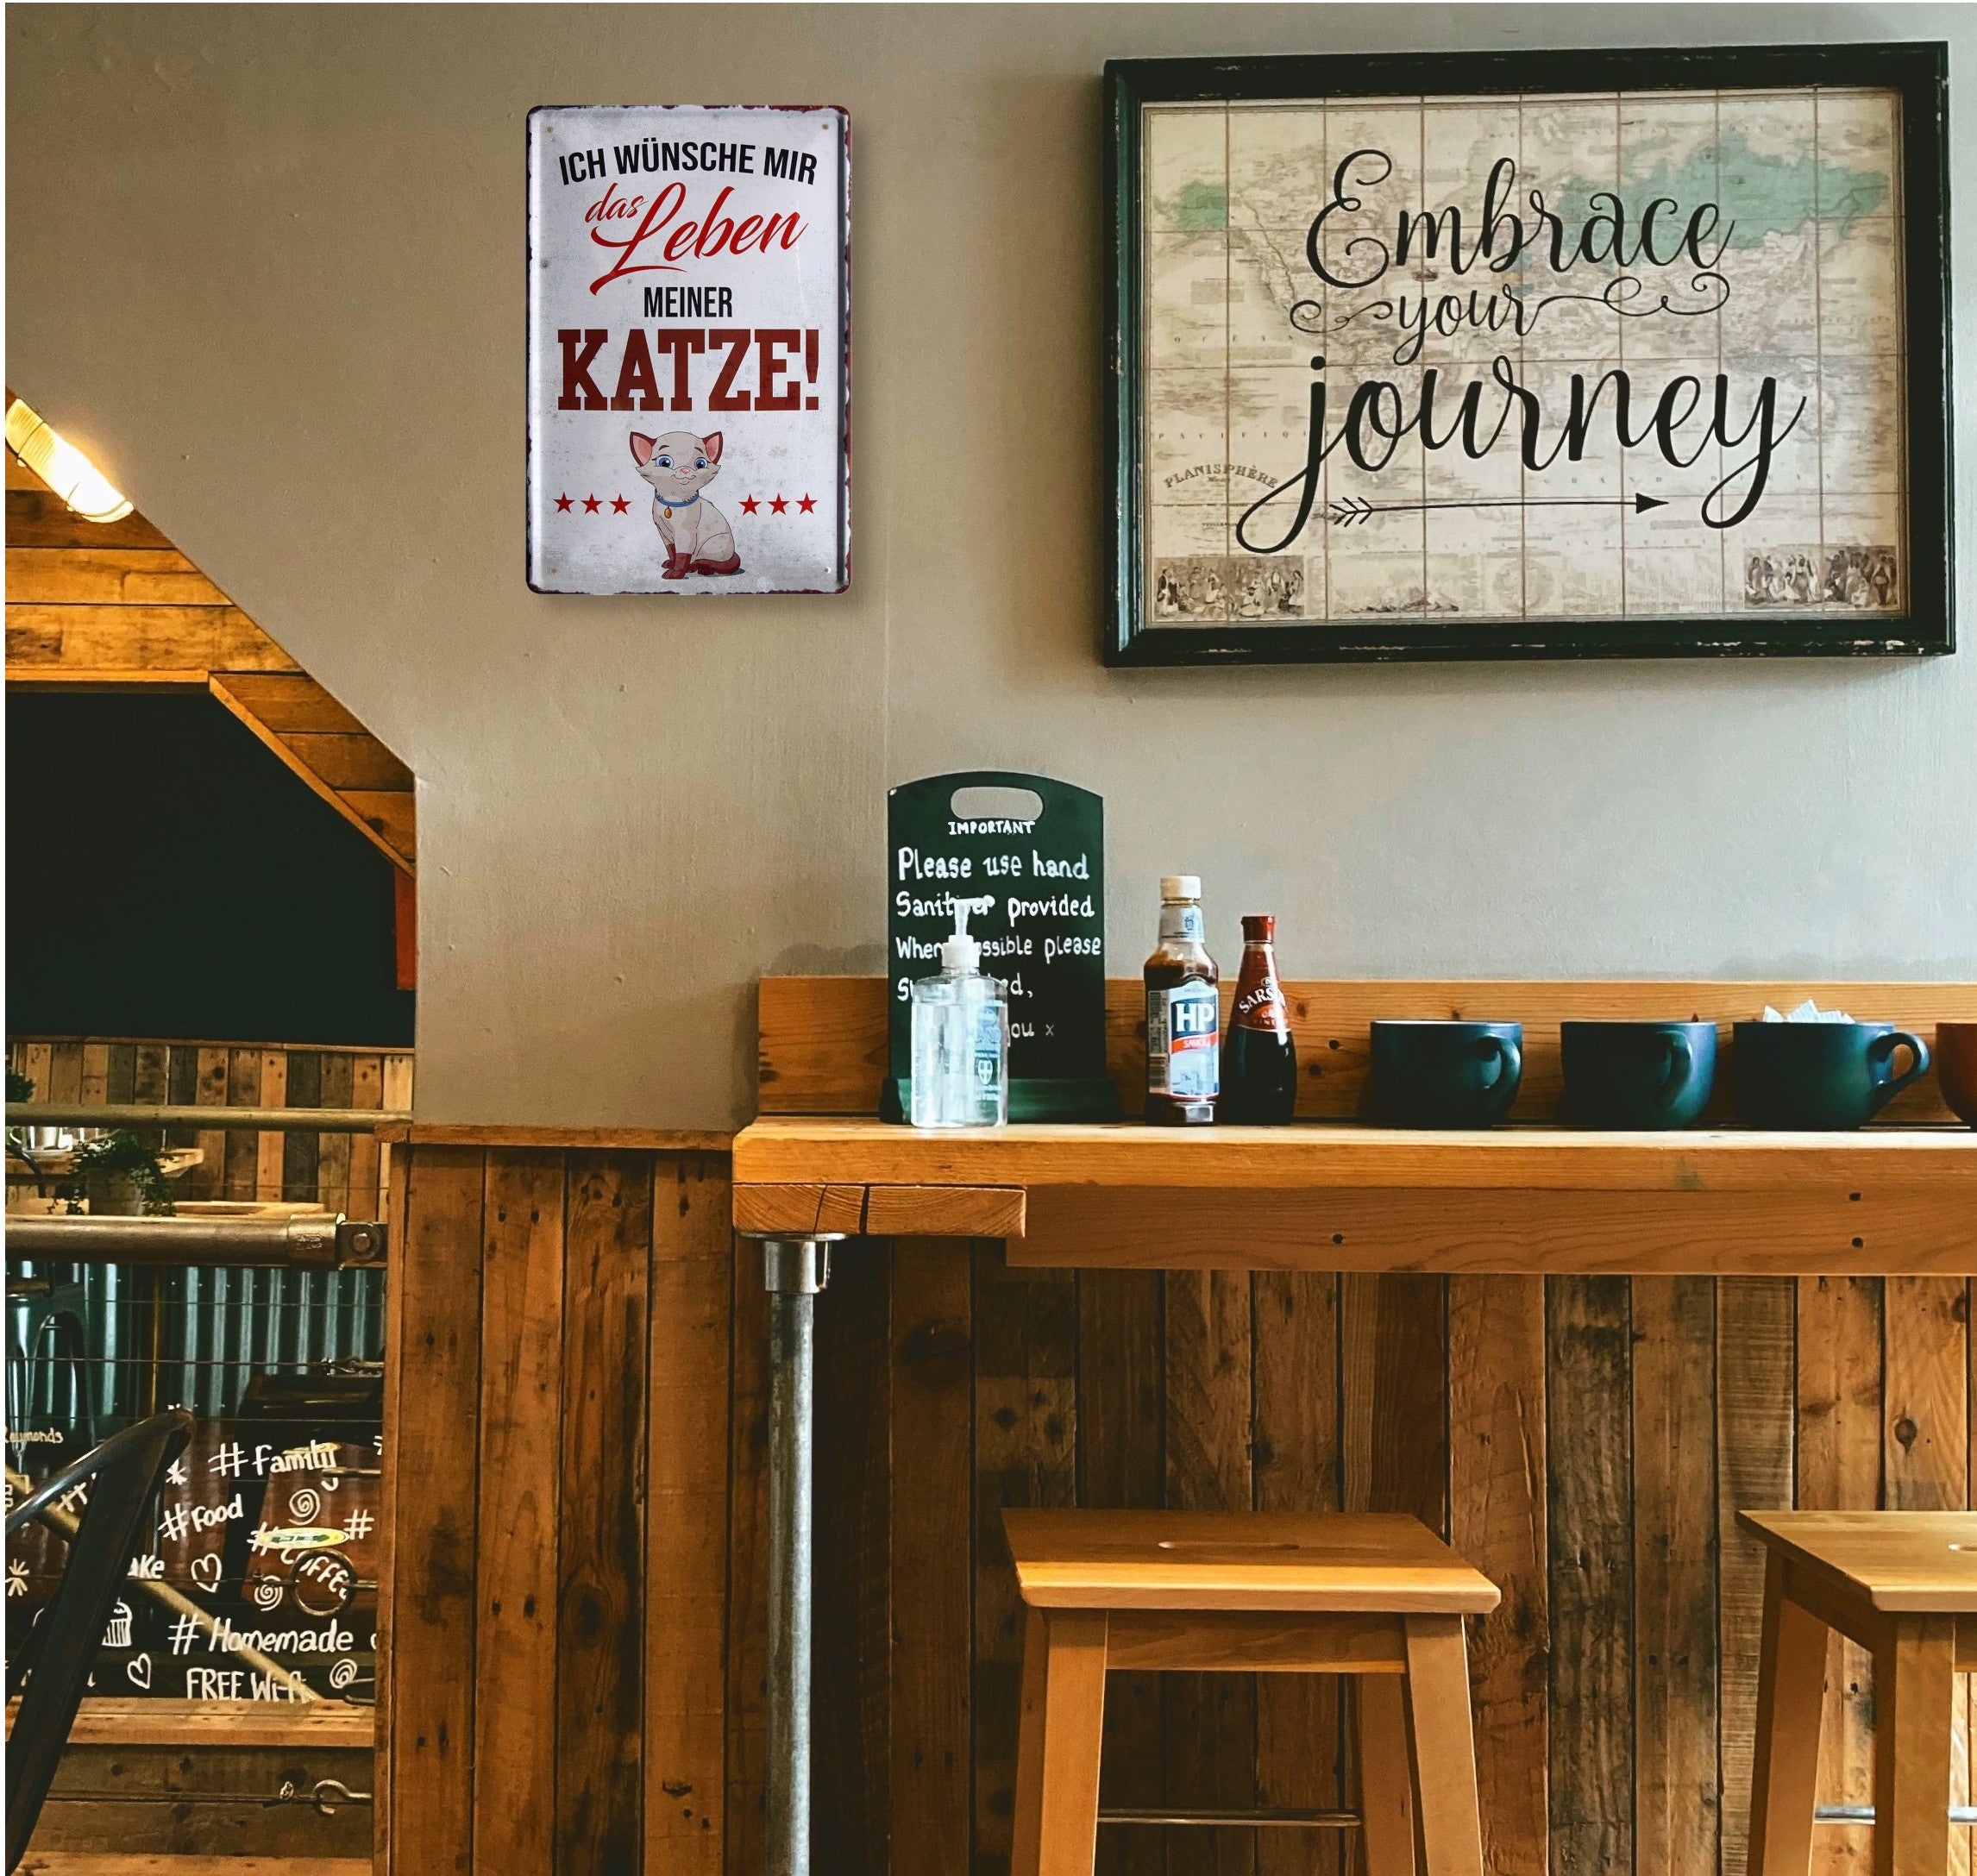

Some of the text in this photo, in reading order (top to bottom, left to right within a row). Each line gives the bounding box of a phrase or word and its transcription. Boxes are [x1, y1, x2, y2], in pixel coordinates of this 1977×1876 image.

[558, 137, 818, 186] ICH WÜNSCHE MIR
[1306, 148, 1736, 289] Embrace
[584, 181, 808, 296] das Leben
[643, 285, 733, 318] MEINER
[1393, 284, 1540, 366] your
[556, 328, 820, 411] KATZE!
[1236, 355, 1807, 554] journey
[1164, 463, 1279, 489] PLANISPHÈRE
[947, 819, 1036, 836] IMPORTANT
[897, 846, 1089, 881] Please use hand
[1007, 894, 1095, 928] provided
[1045, 935, 1102, 963] please
[1176, 1002, 1215, 1032] HP
[186, 1666, 245, 1702] FREE
